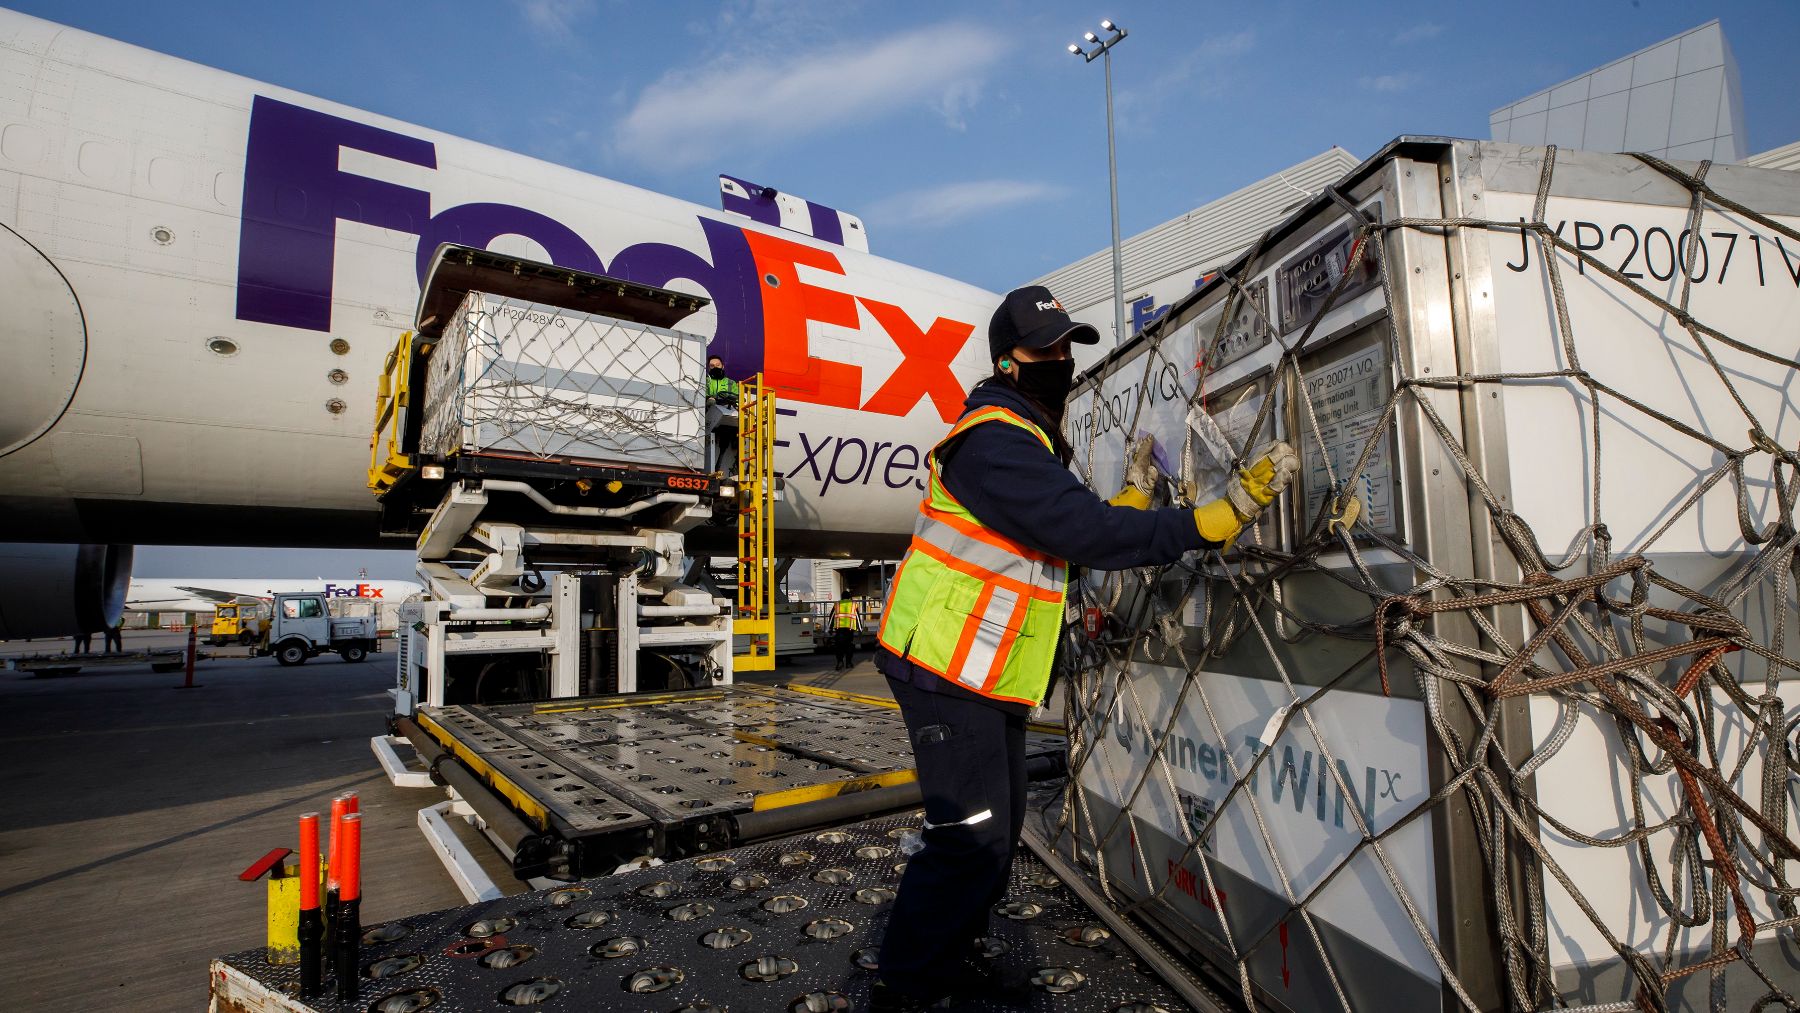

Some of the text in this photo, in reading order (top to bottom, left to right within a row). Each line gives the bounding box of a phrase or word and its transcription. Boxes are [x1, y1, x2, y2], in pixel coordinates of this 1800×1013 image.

[236, 94, 975, 425] FedEx
[1308, 358, 1373, 395] JYP 20071 VQ
[1344, 401, 1359, 413] Unit
[667, 475, 710, 490] 66337
[325, 583, 384, 598] FedEx
[1167, 858, 1198, 901] FORK
